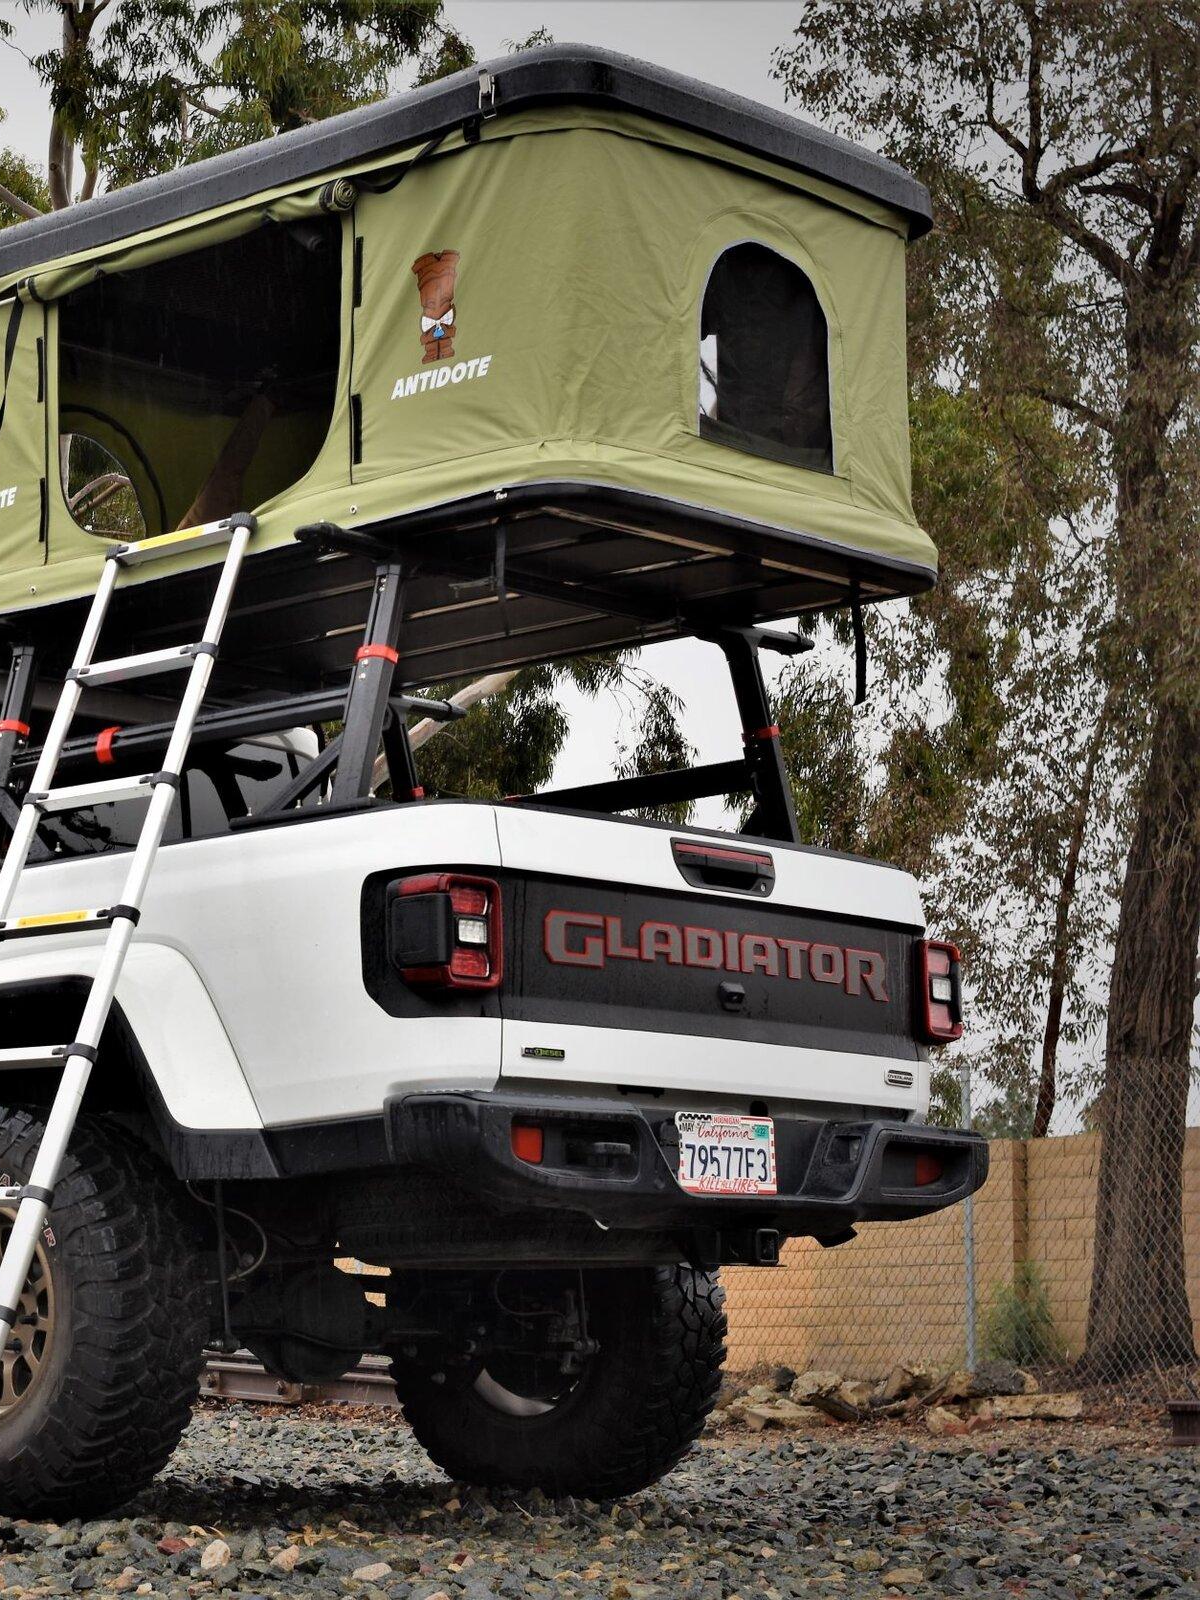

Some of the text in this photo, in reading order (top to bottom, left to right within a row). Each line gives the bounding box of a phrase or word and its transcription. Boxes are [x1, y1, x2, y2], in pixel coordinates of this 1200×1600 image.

[390, 355, 492, 400] ANTIDOTE
[544, 909, 889, 1002] GLADIATOR
[682, 1122, 694, 1132] MAY
[698, 1123, 754, 1143] California
[685, 1144, 768, 1182] 79577F3
